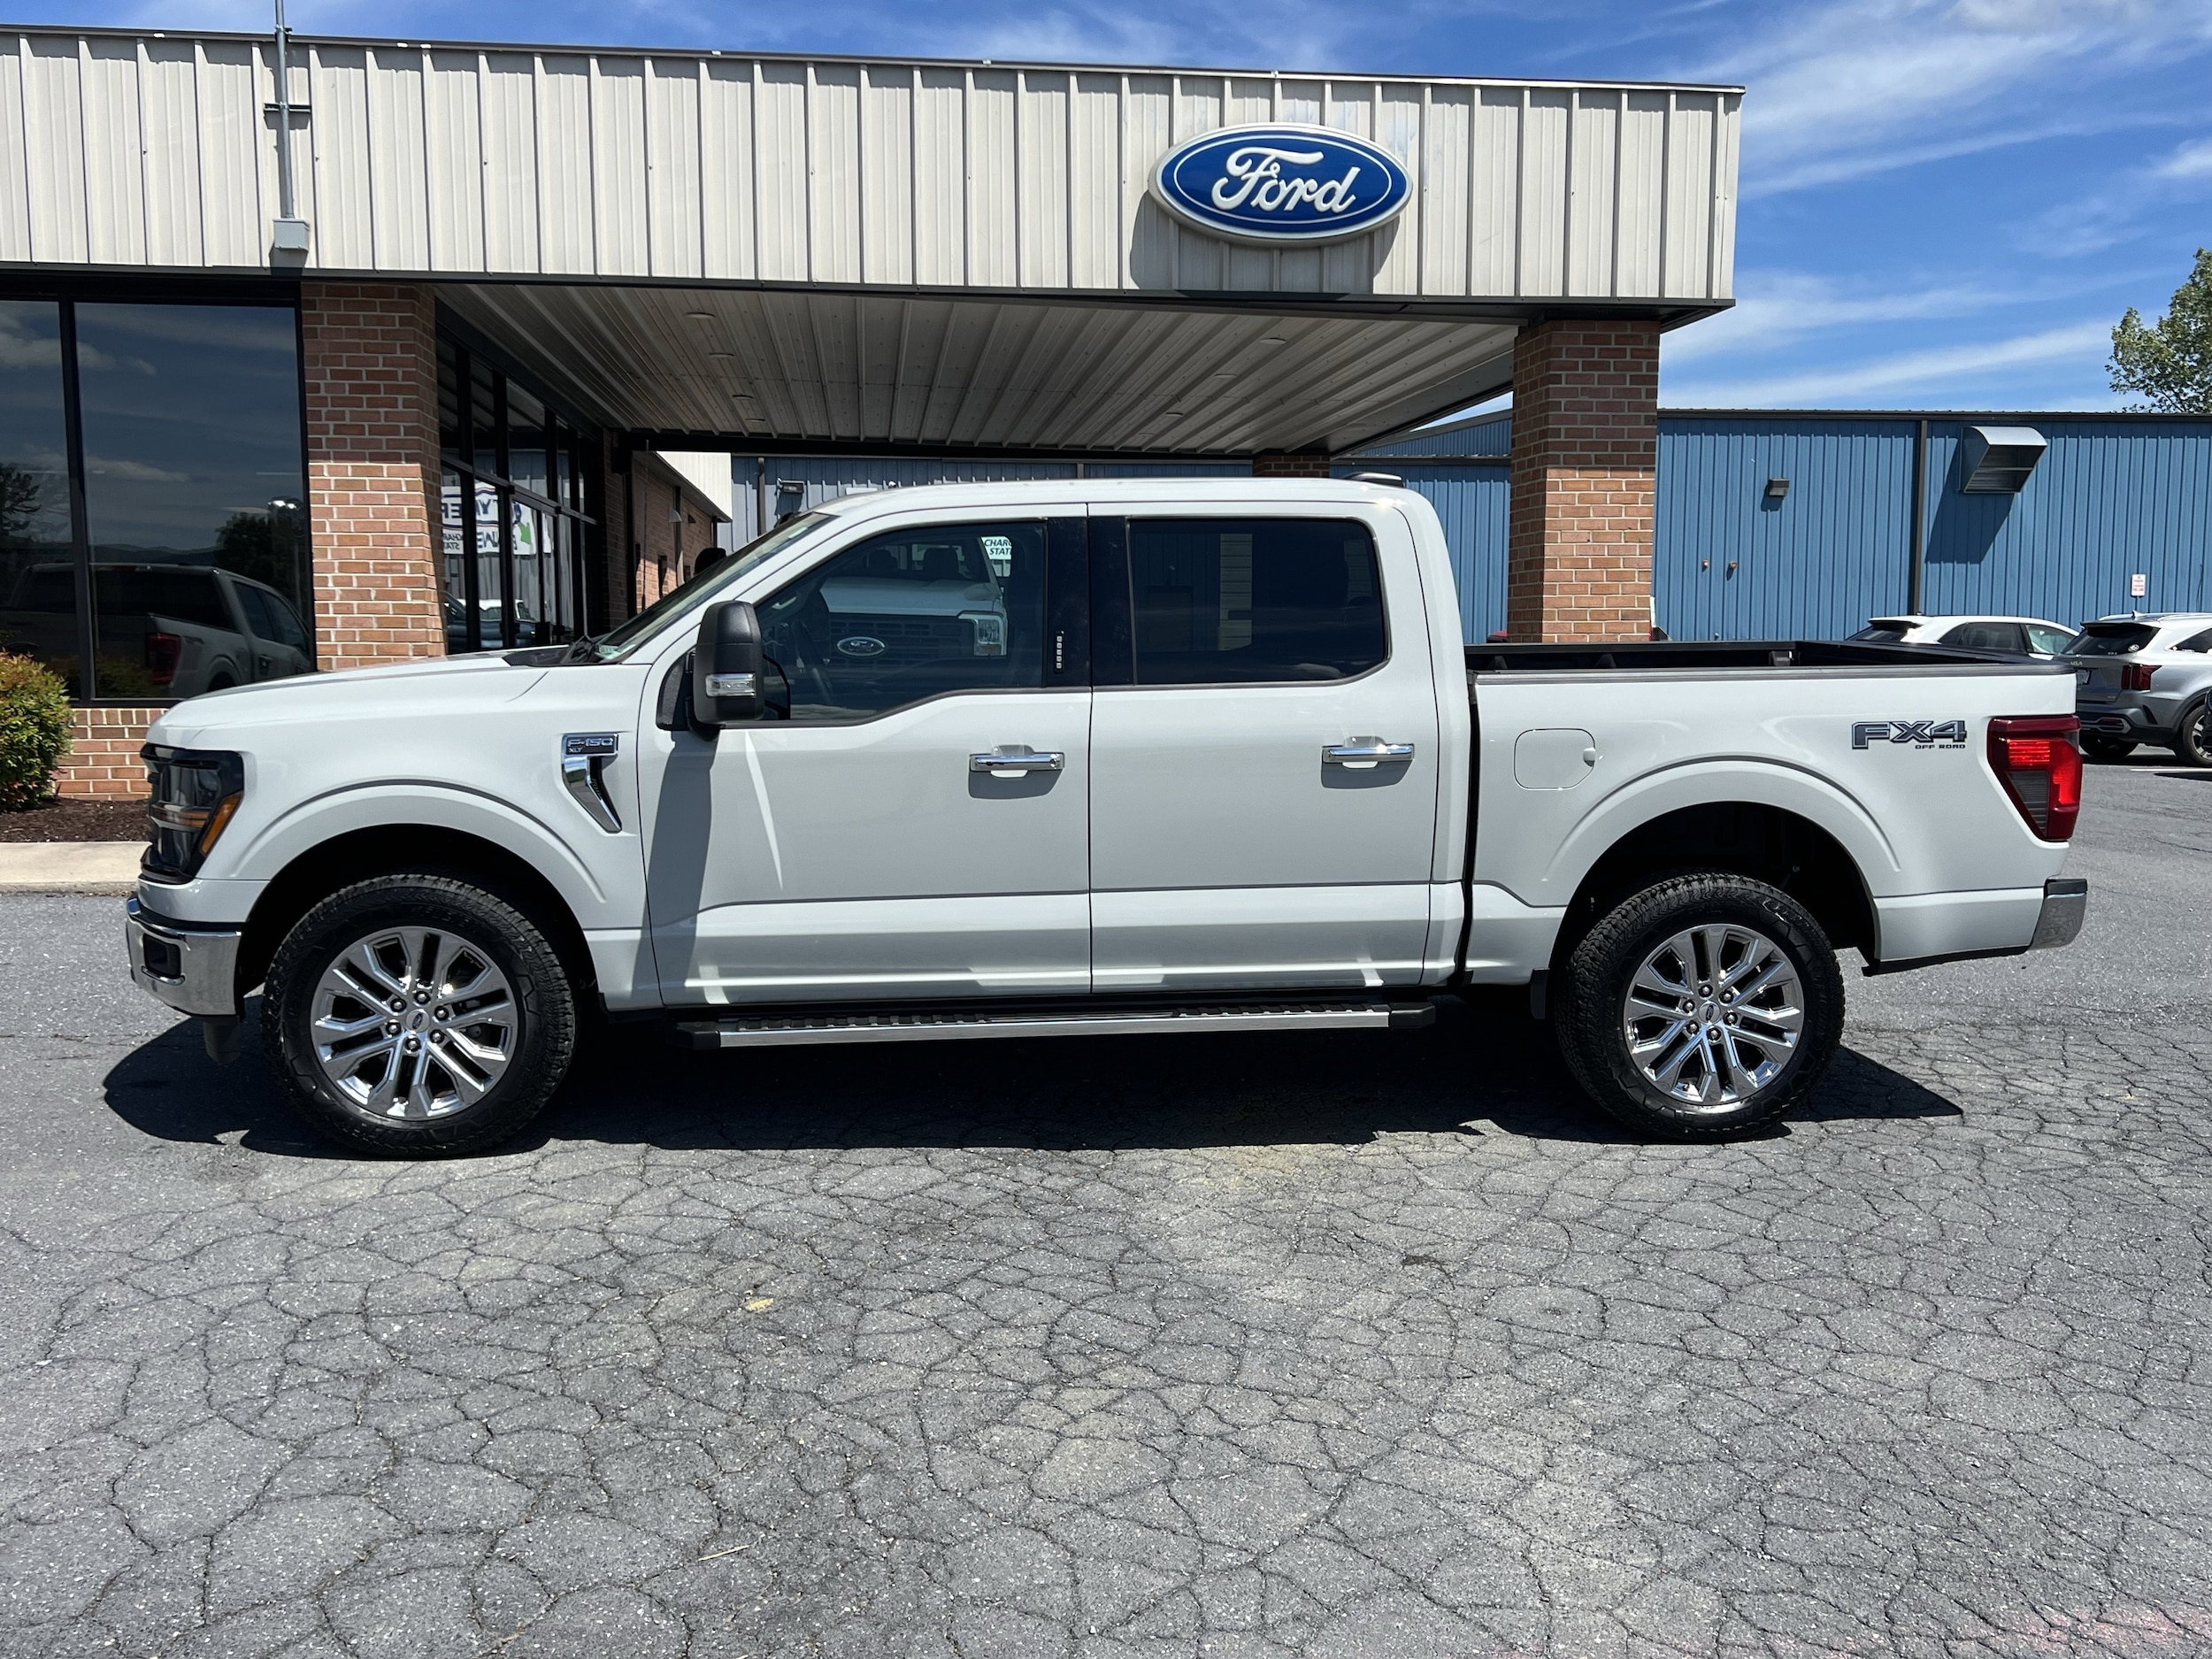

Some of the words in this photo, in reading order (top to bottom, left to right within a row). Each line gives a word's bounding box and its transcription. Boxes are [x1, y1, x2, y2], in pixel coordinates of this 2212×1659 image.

[1211, 146, 1362, 213] Ford
[567, 738, 614, 747] F-150
[1852, 720, 1967, 749] FX4
